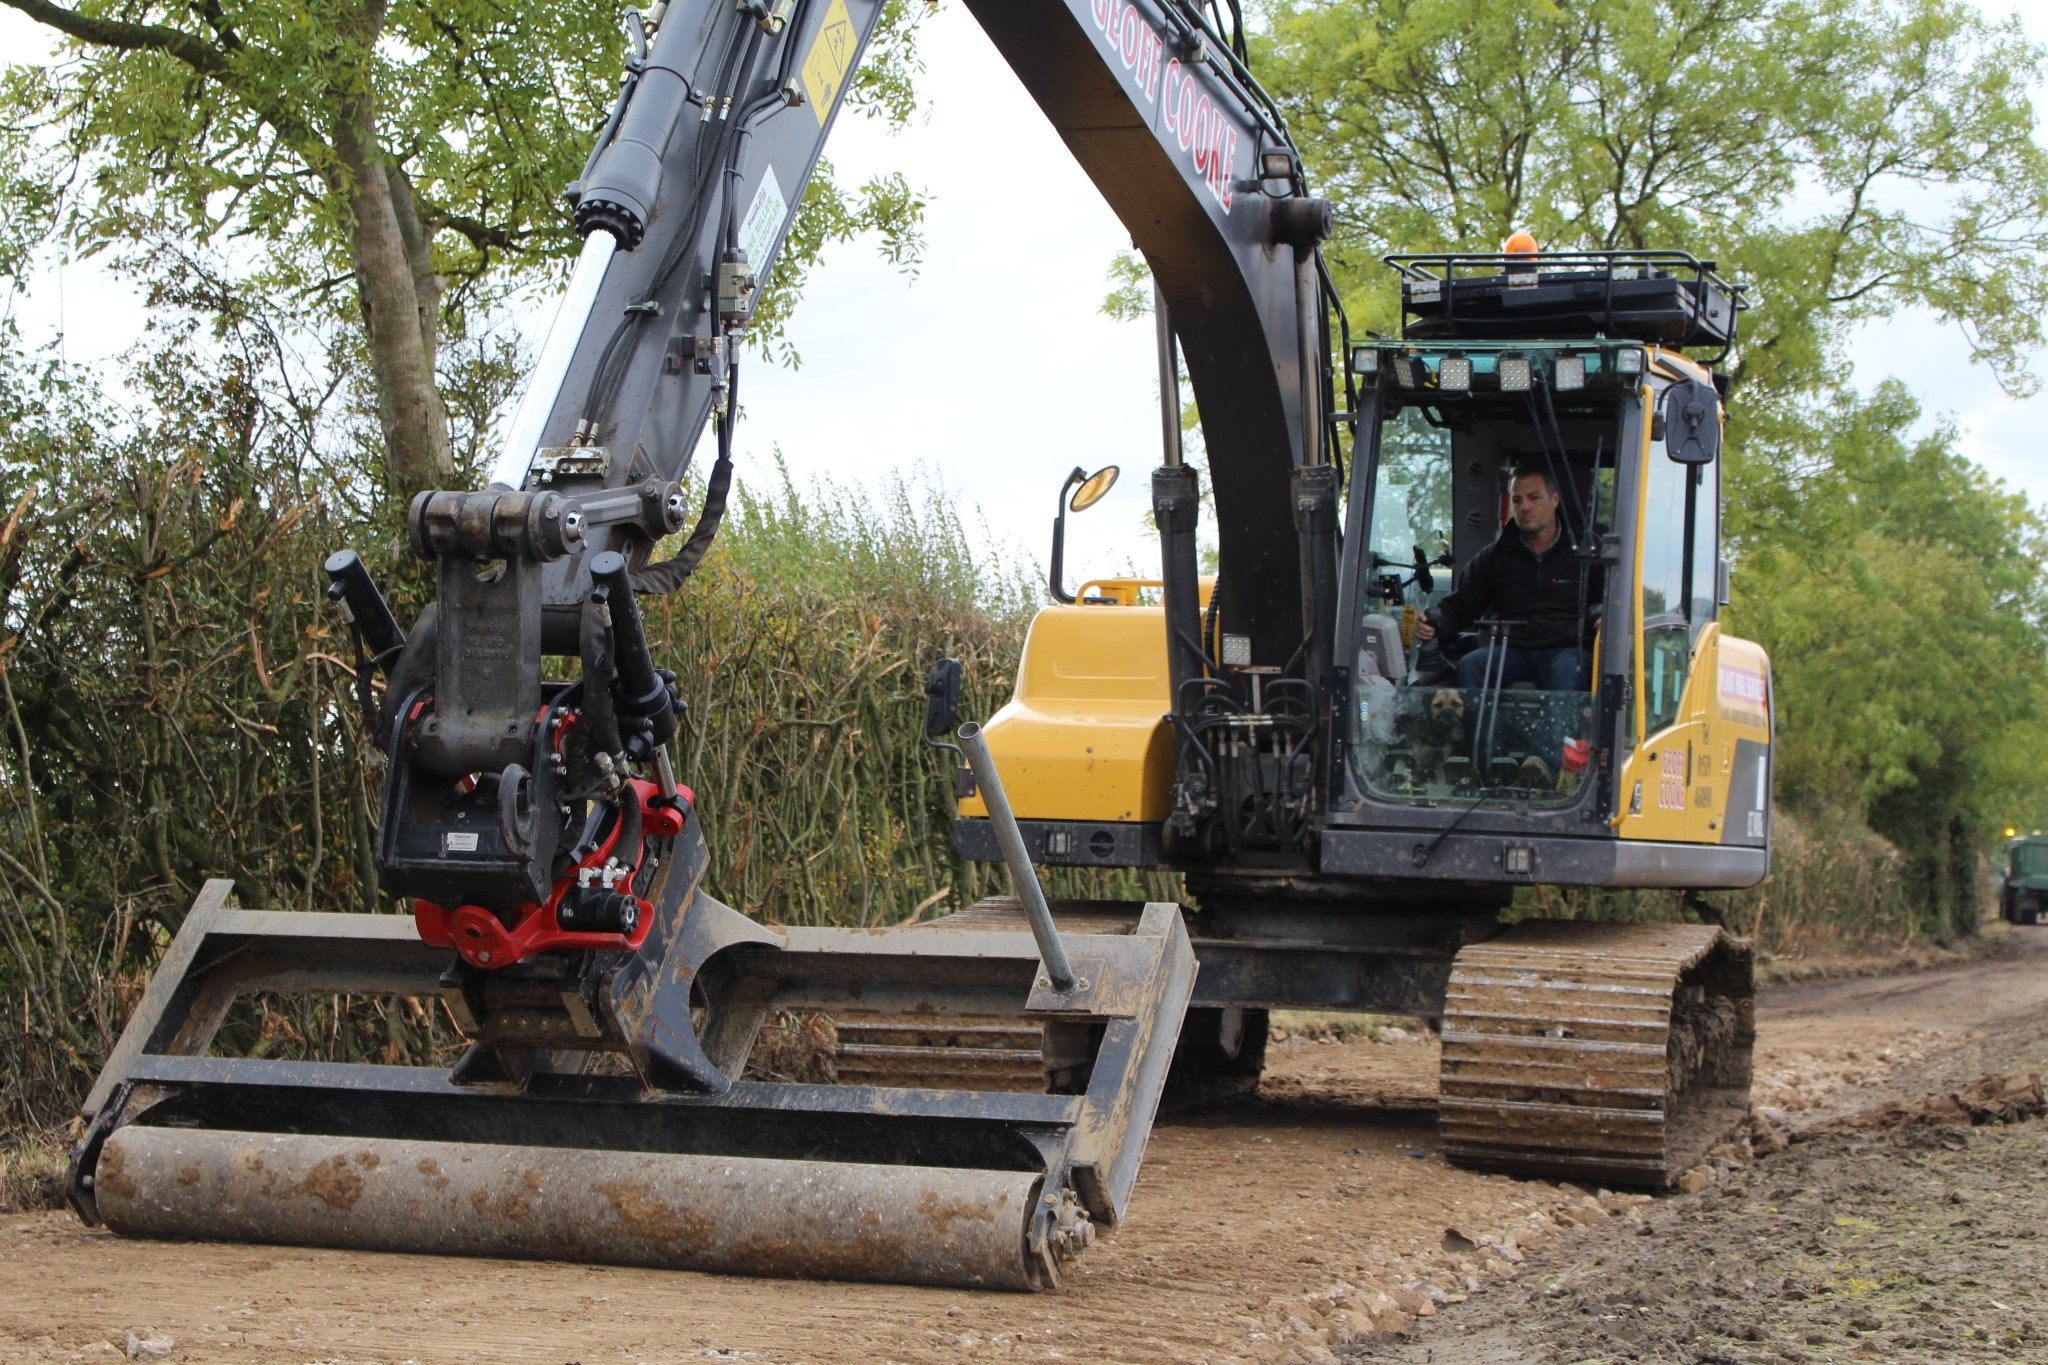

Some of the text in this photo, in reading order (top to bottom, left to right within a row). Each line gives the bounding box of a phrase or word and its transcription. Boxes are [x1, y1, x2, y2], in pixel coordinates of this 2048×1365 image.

[1162, 57, 1237, 216] COOKE
[754, 195, 773, 232] MILLER
[759, 199, 781, 247] COUPLER
[1662, 749, 1685, 779] GEOFF
[1658, 780, 1685, 810] COOKE
